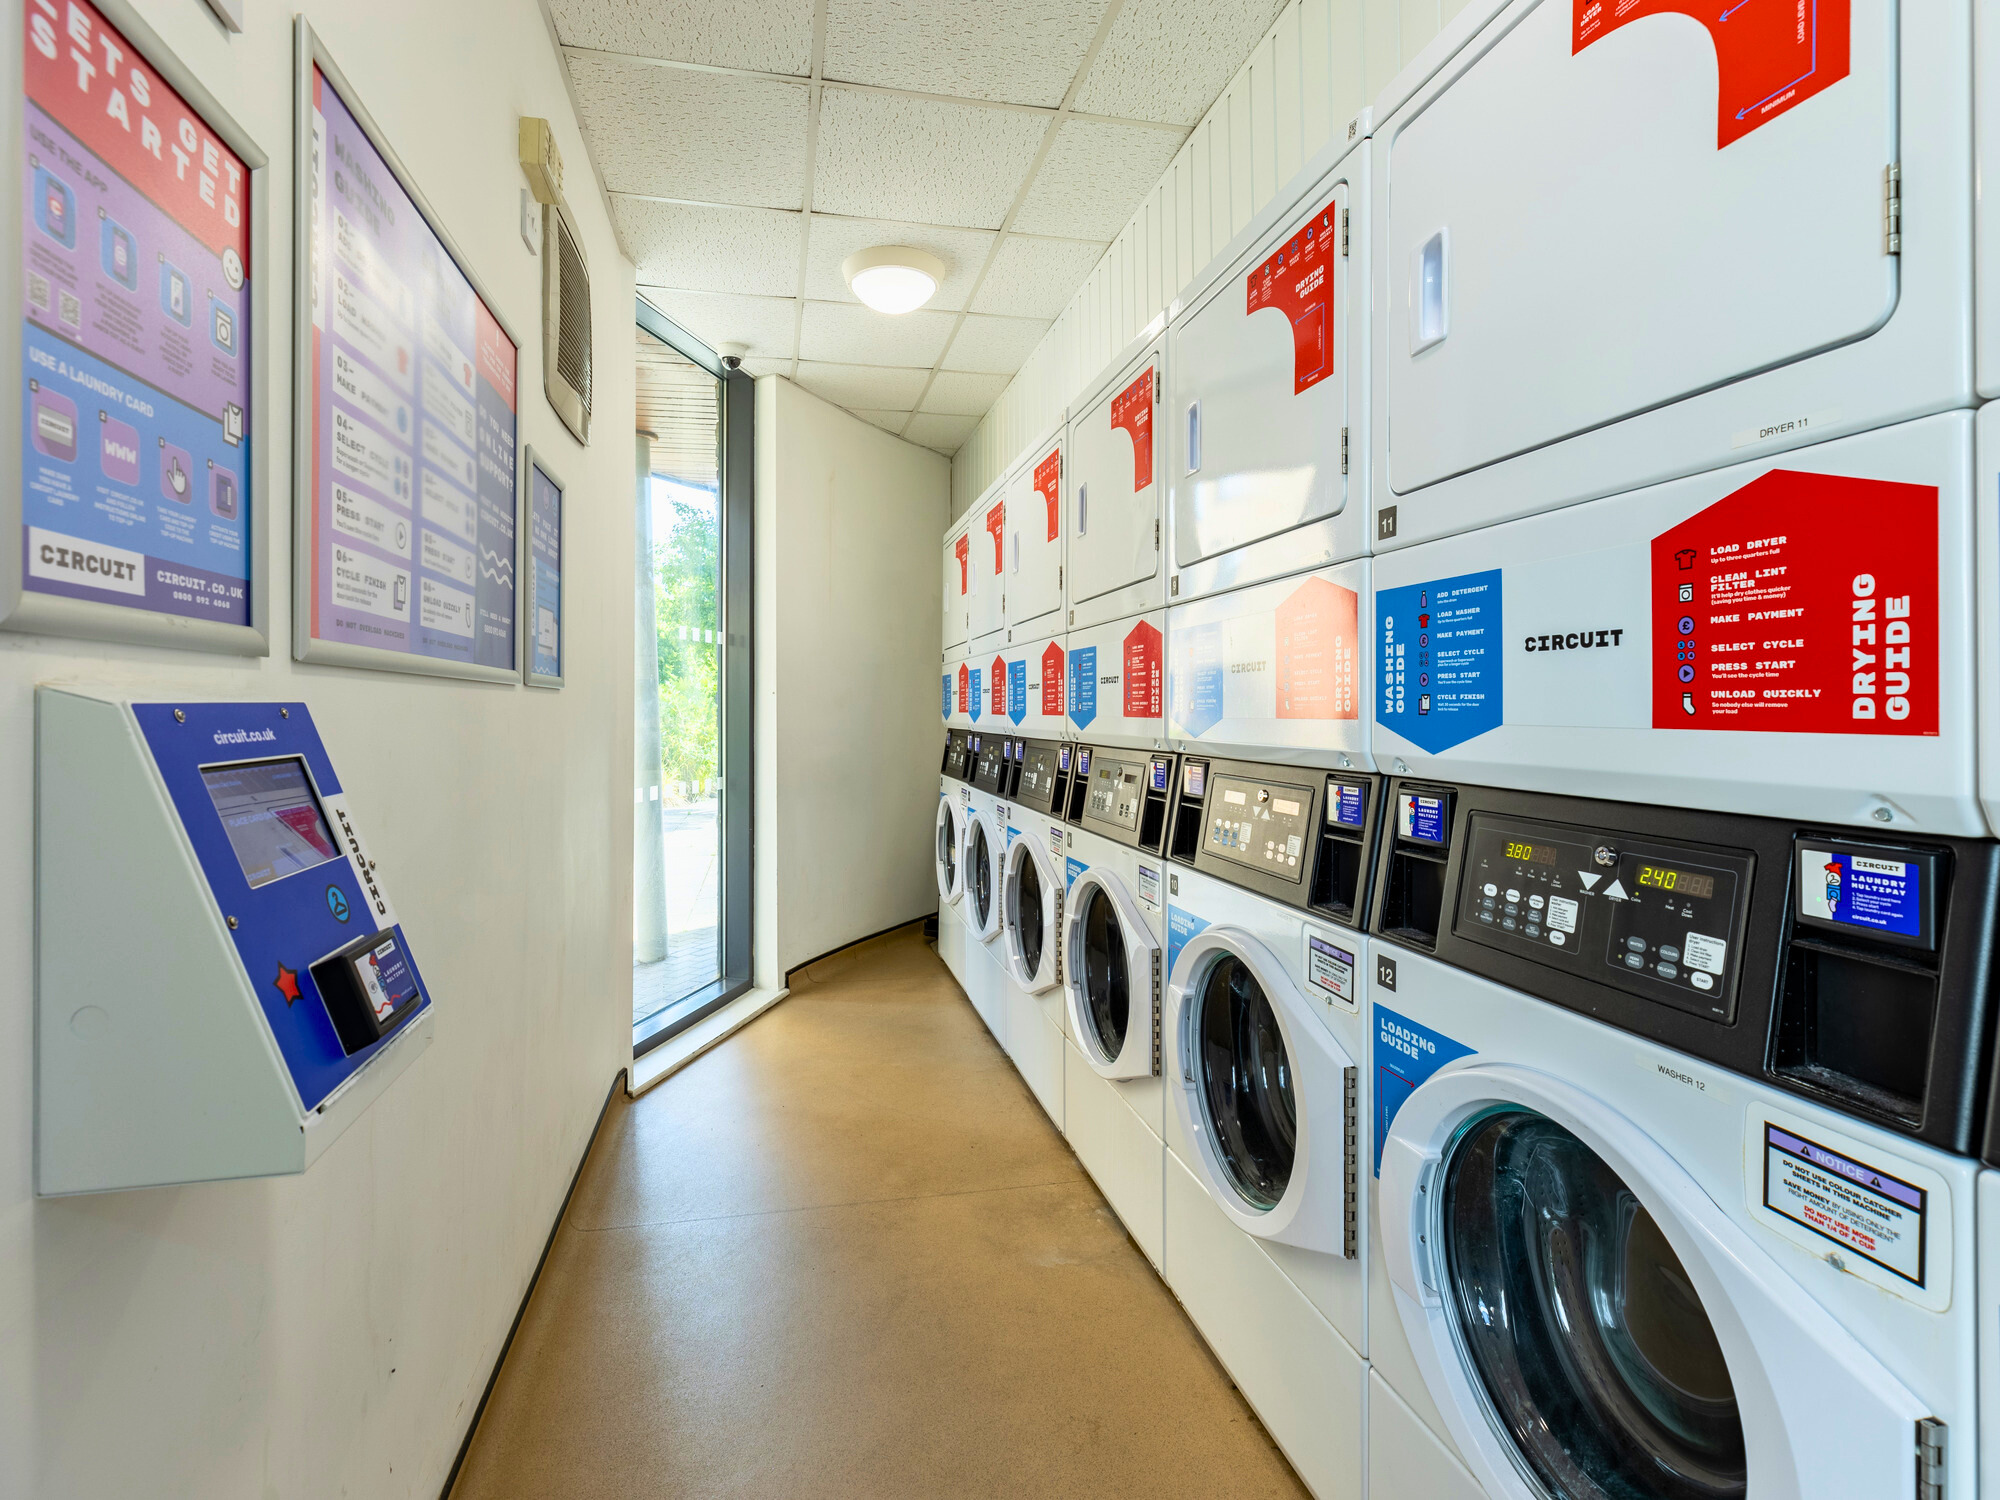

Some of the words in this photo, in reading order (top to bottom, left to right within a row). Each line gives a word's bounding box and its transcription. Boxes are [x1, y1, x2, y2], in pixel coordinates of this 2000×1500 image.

[1580, 6, 1602, 27] DRYER
[1582, 2, 1600, 20] LOAD
[1761, 90, 1796, 114] MINIMUM
[30, 13, 240, 228] STARTED
[29, 124, 54, 157] USE
[56, 144, 82, 176] THE
[83, 164, 108, 194] APP
[179, 118, 240, 194] GET
[334, 134, 396, 227] WASHING
[334, 170, 381, 237] GUIDE
[1295, 265, 1324, 293] DRYING
[1300, 275, 1324, 299] GUIDE
[29, 346, 56, 372] USE
[58, 362, 68, 376] A
[70, 366, 123, 403] LAUNDRY
[125, 394, 154, 418] CARD
[336, 376, 357, 395] MAKE
[501, 427, 514, 449] NEED
[1759, 422, 1793, 438] DRYER
[1798, 418, 1808, 428] 11
[104, 439, 136, 465] WWW
[336, 432, 366, 455] SELECT
[479, 426, 514, 471] ONLINE
[479, 456, 514, 494] SUPPORT?
[336, 504, 360, 523] PRESS
[1382, 517, 1394, 532] 11
[1711, 544, 1740, 555] LOAD
[1747, 536, 1787, 550] DRYER
[1743, 551, 1768, 559] quarters
[40, 544, 136, 582] CIRCUIT
[156, 570, 244, 600] CIRCUIT.CO.UK
[336, 567, 361, 584] CYCLE
[364, 575, 386, 590] FINISH
[1710, 572, 1747, 583] CLEAN
[1756, 566, 1787, 578] LINT
[1452, 585, 1488, 596] DETERGENT
[1711, 580, 1755, 592] FILTER
[1745, 587, 1767, 595] clothes
[1768, 585, 1791, 594] quicker
[1763, 592, 1786, 600] money)
[1456, 607, 1480, 616] WASHER
[1710, 614, 1740, 624] MAKE
[1748, 608, 1804, 621] PAYMENT
[1456, 628, 1484, 637] PAYMENT
[1524, 628, 1624, 653] CIRCUIT
[1711, 642, 1755, 652] SELECT
[1763, 639, 1804, 649] CYCLE
[1852, 574, 1876, 719] DRYING
[1231, 661, 1266, 673] CIRCUIT
[1385, 616, 1393, 713] WASHING
[1711, 663, 1747, 671] PRESS
[1756, 660, 1796, 670] START
[1886, 595, 1910, 720] GUIDE
[1396, 643, 1405, 713] GUIDE
[1711, 690, 1756, 698] UNLOAD
[1763, 689, 1821, 698] QUICKLY
[213, 728, 276, 745] circuit.co.uk
[336, 808, 386, 915] CIRCUIT
[1506, 843, 1532, 860] 3.80
[1856, 861, 1900, 872] CIRCUIT
[1171, 878, 1177, 890] 10
[1640, 867, 1677, 889] 2.40
[1851, 874, 1906, 888] LAUNDRY
[1851, 882, 1906, 896] MULTIPAY
[1170, 912, 1195, 931] LOADING
[1170, 922, 1188, 936] GUIDE
[1852, 914, 1887, 925] circuit.co.uk
[377, 943, 392, 956] CIRCUIT
[1660, 950, 1678, 958] COLOURS
[384, 961, 403, 978] LAUNDRY
[1380, 966, 1393, 985] 12
[1657, 966, 1676, 975] DELICATES
[1381, 1018, 1436, 1055] LOADING
[1381, 1032, 1419, 1060] GUIDE
[1657, 1064, 1692, 1088] WASHER
[1694, 1080, 1706, 1091] 12
[1816, 1151, 1864, 1181] NOTICE
[1783, 1160, 1793, 1168] DO
[1794, 1165, 1810, 1175] NOT
[1812, 1172, 1827, 1183] USE
[1829, 1180, 1862, 1201] COLOUR
[1863, 1195, 1902, 1220] CATCHER
[1792, 1170, 1821, 1189] SHEETS
[1823, 1185, 1831, 1193] IN
[1833, 1190, 1850, 1202] THIS
[1852, 1199, 1891, 1221] MACHINE
[1783, 1178, 1801, 1192] SAVE
[1803, 1188, 1830, 1205] MONEY
[1832, 1202, 1841, 1210] BY
[1842, 1206, 1864, 1222] USING
[1866, 1217, 1885, 1231] ONLY
[1886, 1227, 1901, 1240] THE
[1788, 1188, 1808, 1202] RIGHT
[1809, 1197, 1837, 1216] AMOUNT
[1839, 1212, 1848, 1221] OF
[1850, 1217, 1894, 1243] DETERGENT
[1804, 1205, 1815, 1214] DO
[1816, 1211, 1832, 1223] NOT
[1834, 1220, 1850, 1232] USE
[1852, 1228, 1876, 1245] MORE
[1804, 1212, 1824, 1227] THAN
[1827, 1222, 1837, 1233] 1/4
[1839, 1228, 1850, 1238] OF
[1859, 1239, 1876, 1251] CUP
